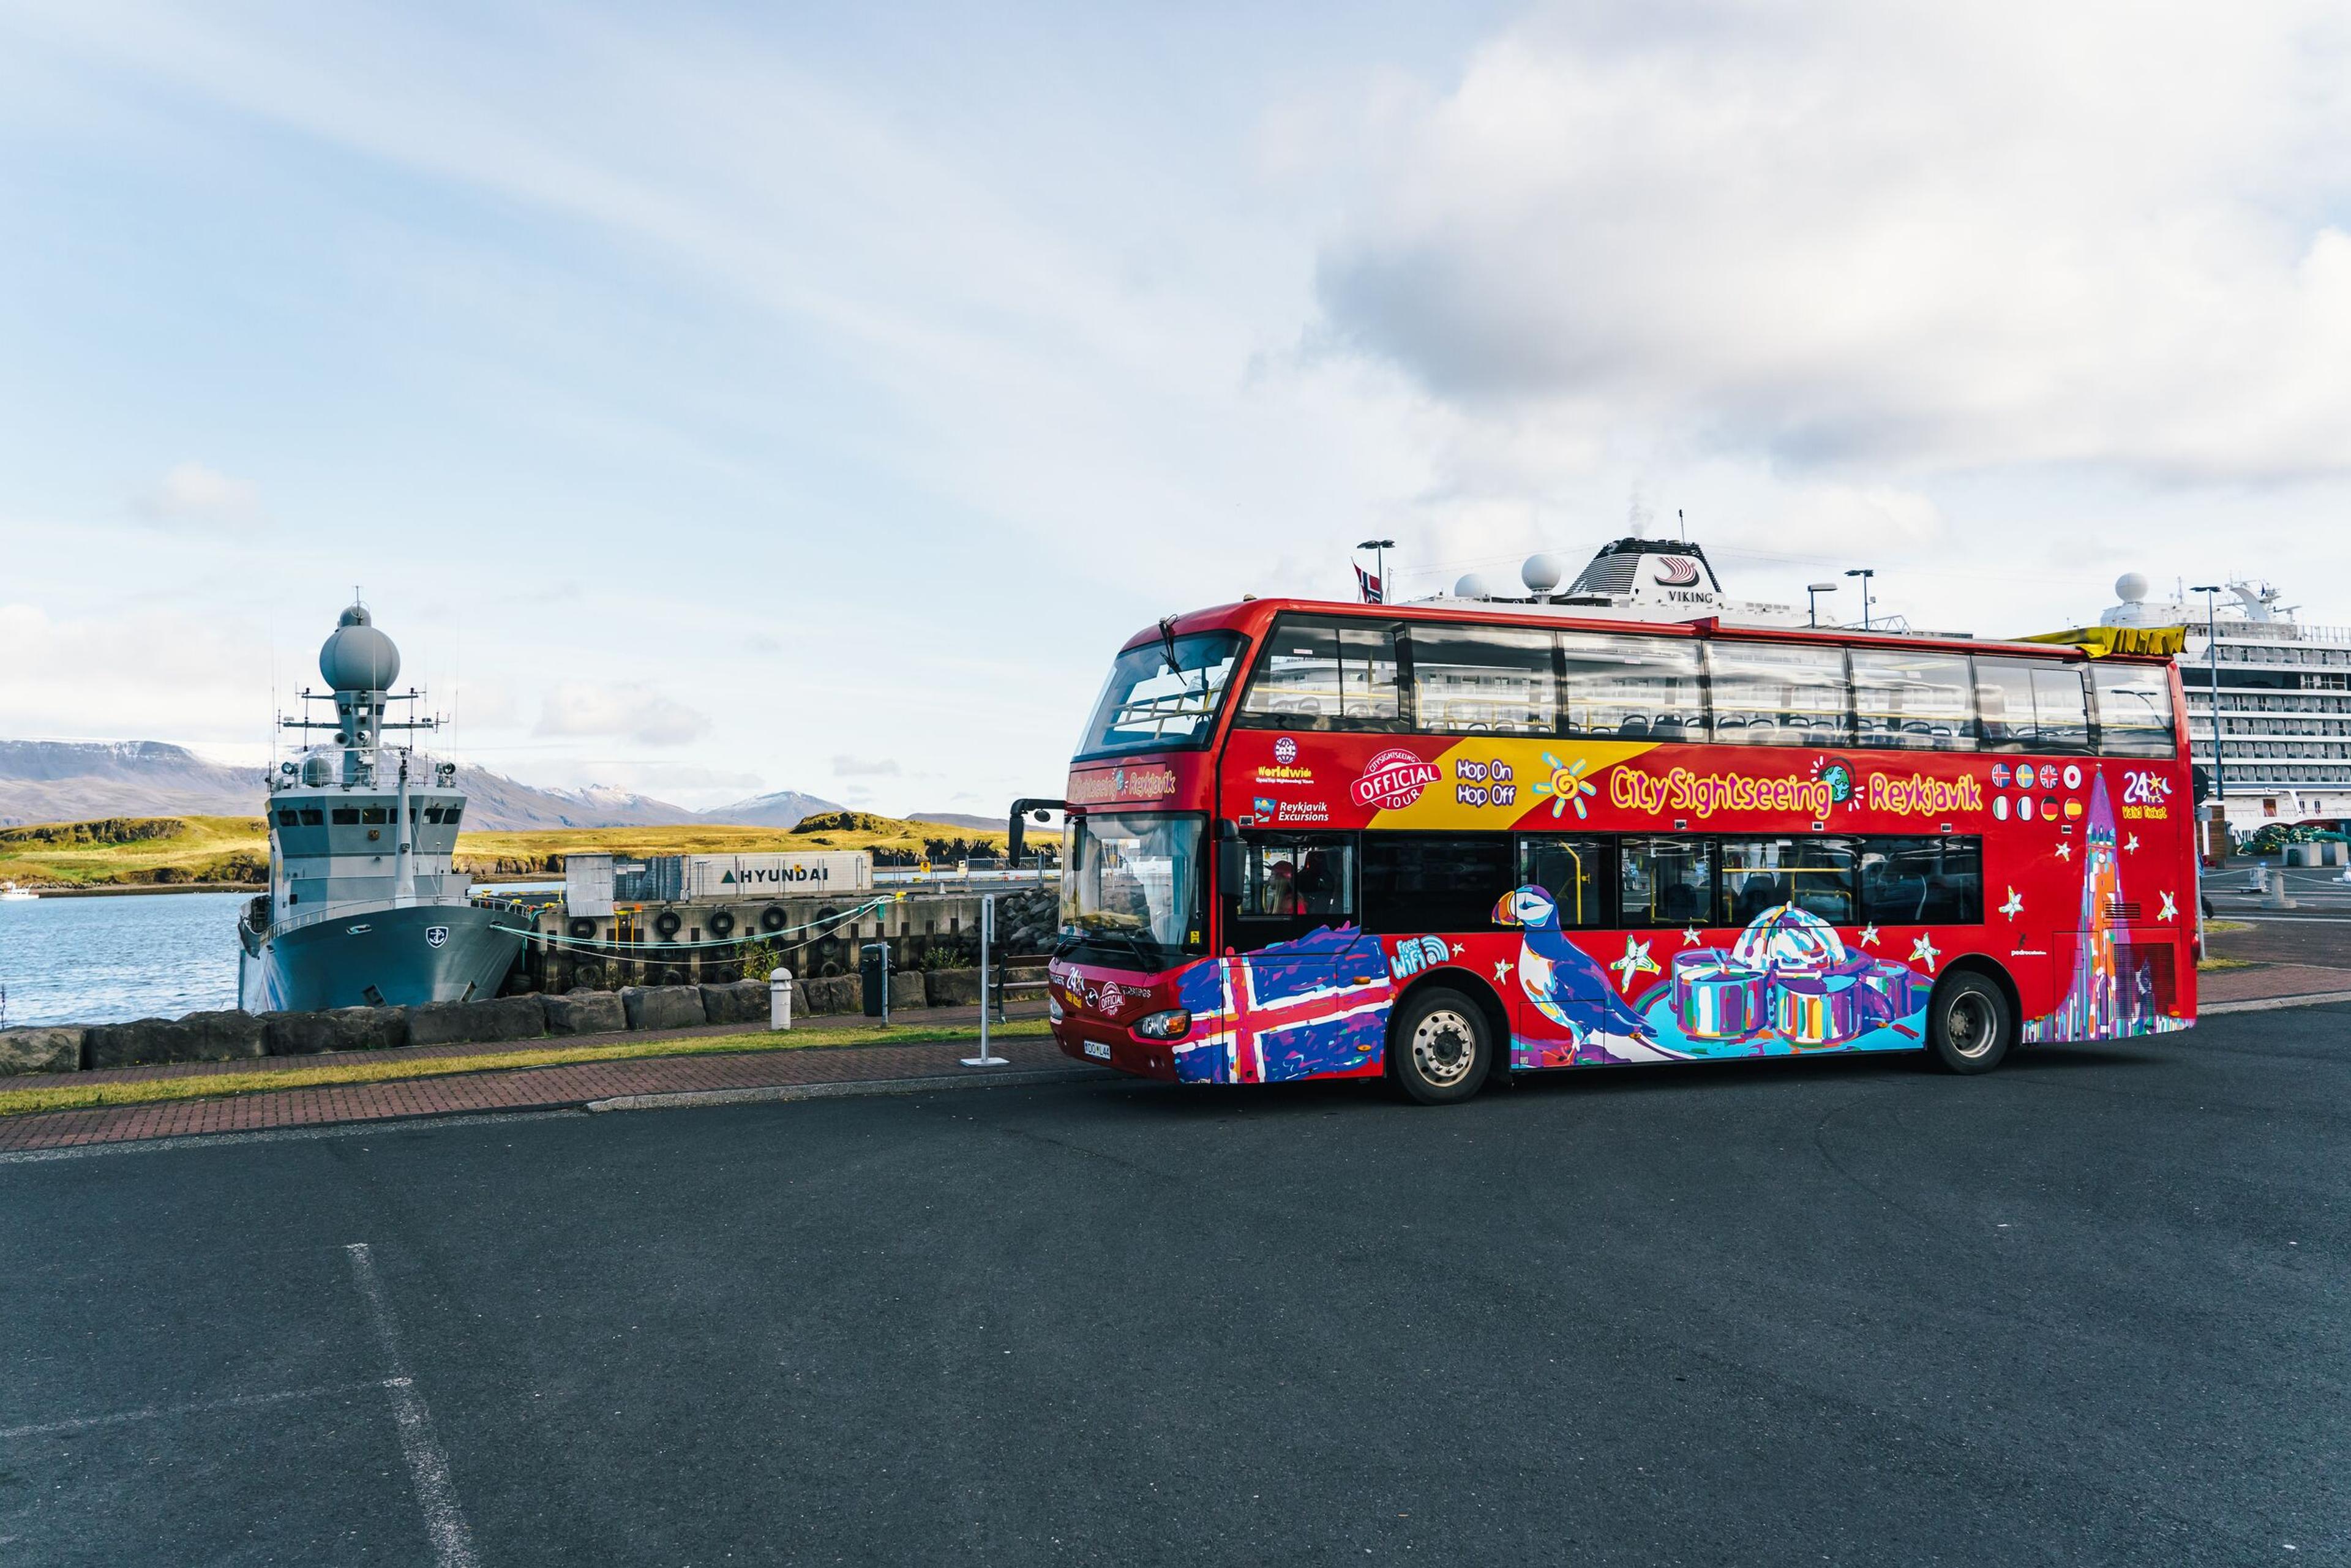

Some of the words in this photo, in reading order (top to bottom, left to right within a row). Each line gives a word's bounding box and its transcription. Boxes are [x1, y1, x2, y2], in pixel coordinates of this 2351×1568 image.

[1668, 590, 1714, 604] VIKING
[1369, 751, 1415, 772] CITYSIGHTSEEING
[1457, 759, 1488, 782] Hop
[1491, 759, 1512, 781] On
[1258, 765, 1311, 778] Worldwide
[1129, 770, 1176, 797] Reykjavik
[1360, 766, 1438, 799] OFFICIAL
[2124, 771, 2149, 803] 24
[1386, 789, 1420, 808] TOUR
[1457, 784, 1488, 808] Hop
[1491, 784, 1517, 806] Off
[1610, 765, 1832, 820] CitySightseeing
[1869, 772, 1983, 817] Reykjavik
[1278, 811, 1329, 821] Excursions
[1280, 801, 1327, 813] Reykjavik
[740, 868, 828, 883] HYUNDAI
[1397, 938, 1420, 955] Free
[1101, 994, 1123, 1008] OFFICIAL
